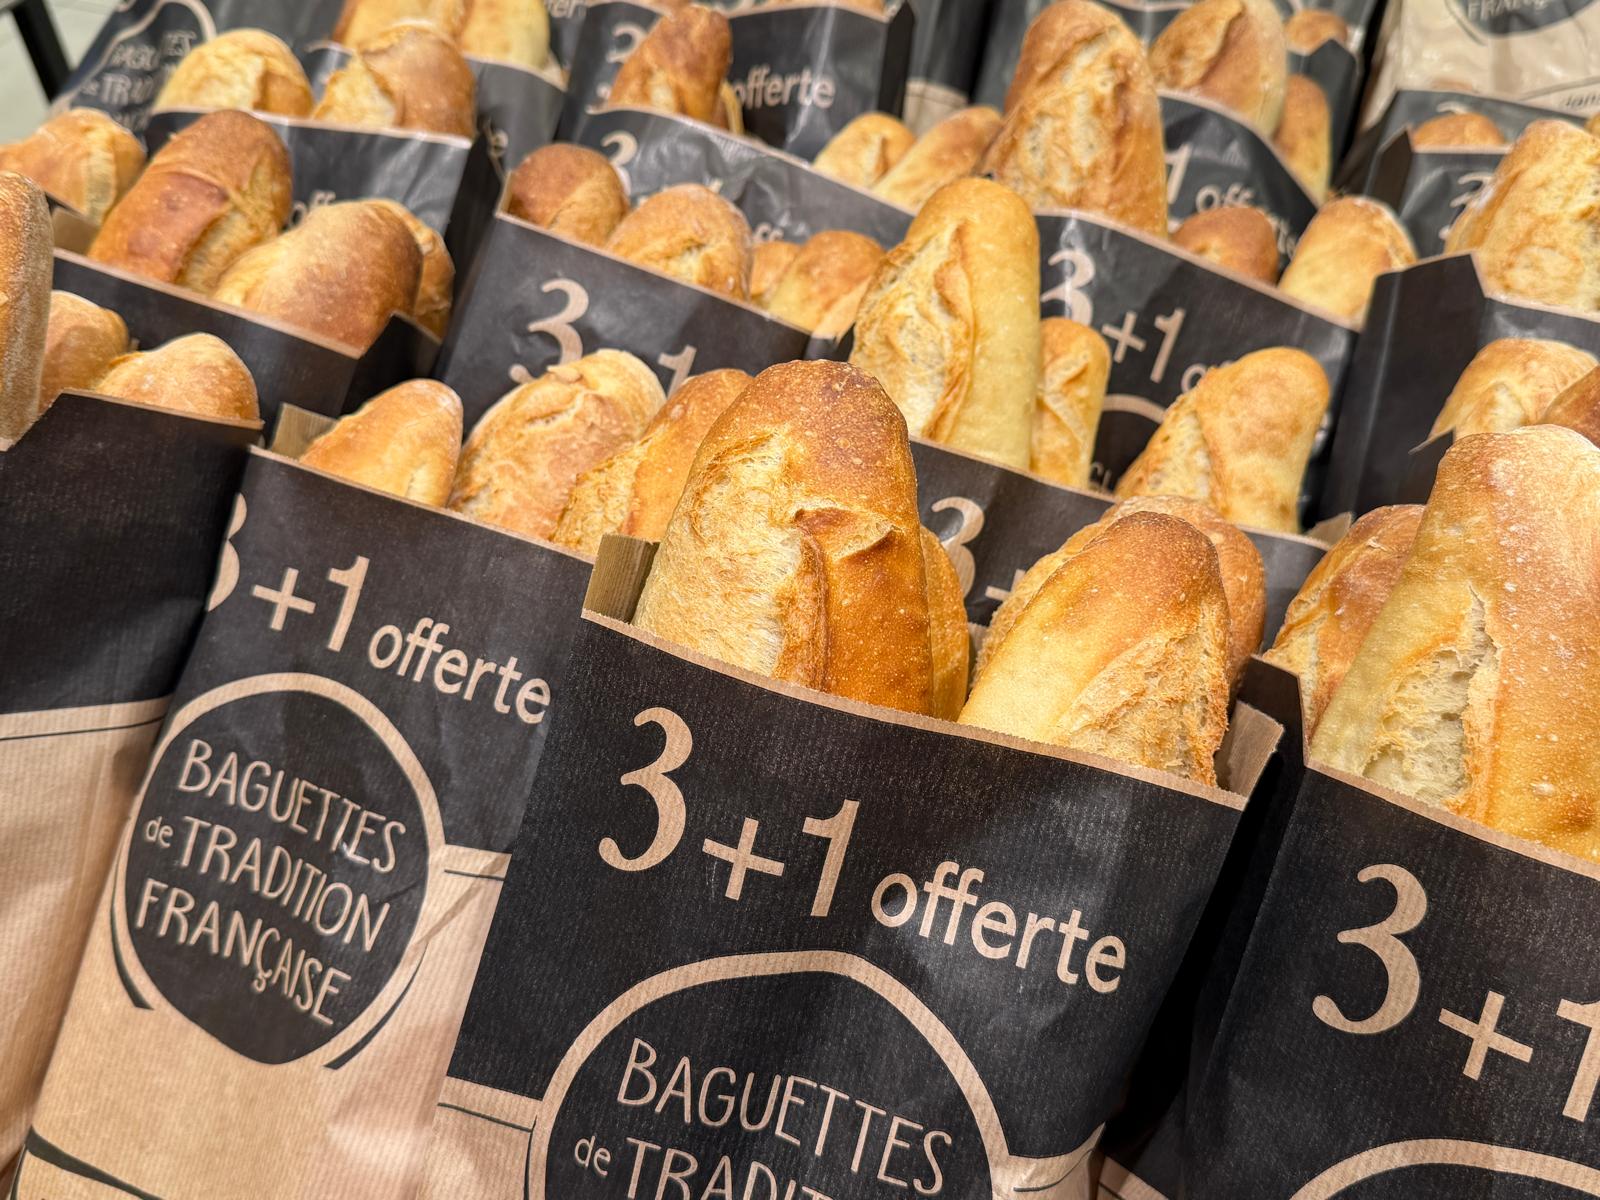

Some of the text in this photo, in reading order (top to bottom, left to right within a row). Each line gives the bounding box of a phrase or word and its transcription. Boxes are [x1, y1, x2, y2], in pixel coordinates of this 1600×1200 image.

[368, 617, 551, 724] offerte
[177, 738, 406, 874] BAGUETTES
[135, 878, 351, 1025] FRANÇAISE
[145, 816, 390, 952] de TRADITION
[871, 861, 1127, 993] offerte
[574, 1135, 834, 1200] de TRAD
[617, 1037, 952, 1195] BAGUETTES
